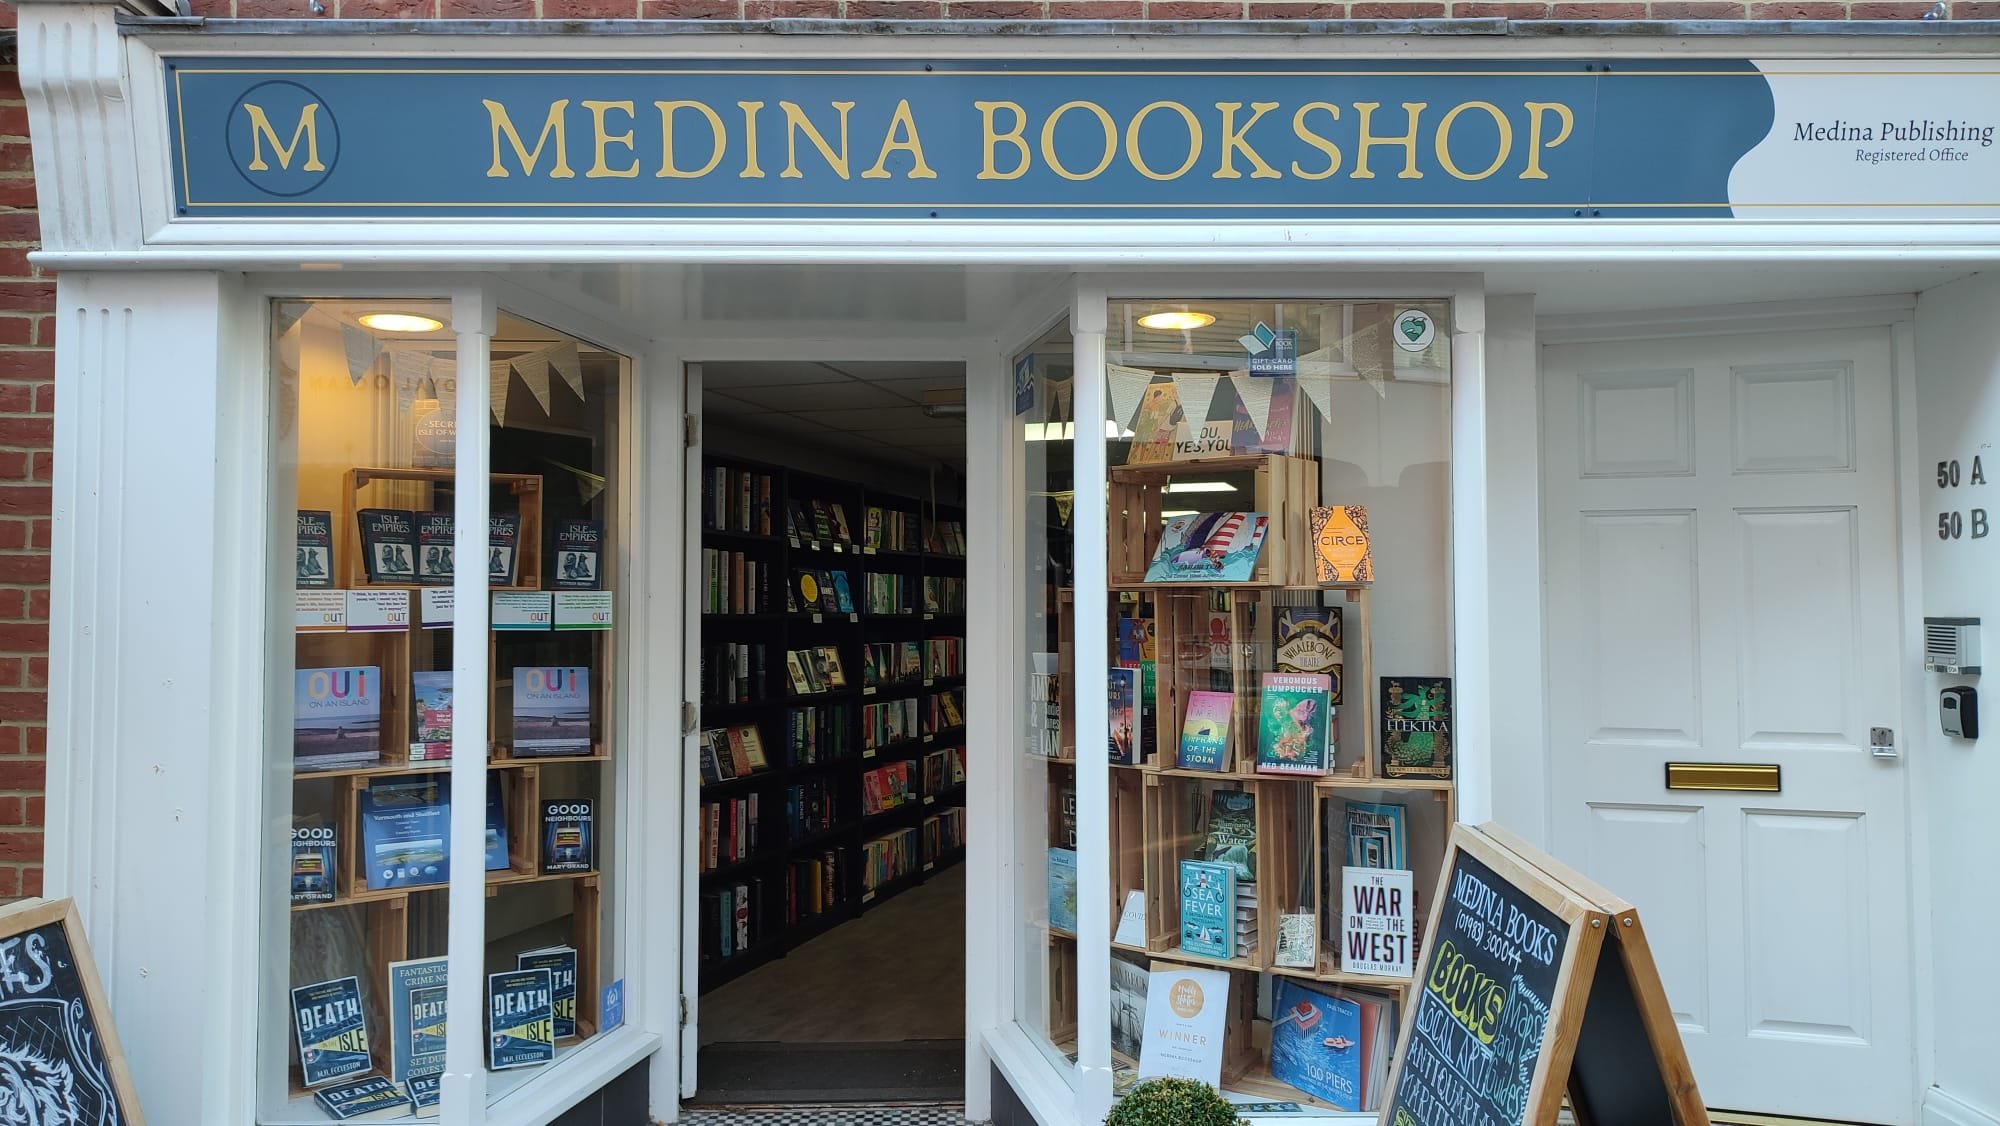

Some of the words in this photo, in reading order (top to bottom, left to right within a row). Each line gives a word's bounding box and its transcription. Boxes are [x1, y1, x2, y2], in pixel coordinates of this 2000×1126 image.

[244, 102, 326, 172] M
[482, 98, 938, 180] MEDINA
[973, 100, 1575, 181] BOOKSHOP
[1793, 120, 1873, 141] Medina
[1880, 119, 1995, 147] Publishing
[1855, 147, 1926, 165] Registered
[1928, 148, 1969, 161] Office
[1200, 427, 1221, 439] OU,
[1937, 460, 1960, 489] 50
[1970, 455, 1987, 485] A
[297, 517, 315, 526] SLE
[380, 515, 400, 524] ISLE
[431, 517, 451, 526] ISLE
[489, 518, 505, 526] SLE
[1938, 511, 1963, 540] 50
[1971, 508, 1990, 539] B
[298, 525, 327, 535] PIRES
[372, 523, 410, 533] EMPIRES
[421, 525, 455, 535] EMPIRE
[489, 527, 514, 536] PIRES
[569, 525, 588, 533] ISLE
[560, 533, 598, 542] EMPIRES
[1321, 536, 1364, 546] CIRCE
[1282, 641, 1336, 660] WHALEBONE
[1273, 676, 1318, 685] VENOMOUS
[1267, 685, 1323, 694] LUMPSUCKER
[1387, 720, 1449, 732] ELEKTRA
[1184, 736, 1225, 745] ORPHANS
[1186, 745, 1199, 753] OF
[1201, 746, 1217, 754] THE
[1185, 754, 1214, 764] STORM
[1280, 763, 1318, 772] BEAUMAN
[547, 804, 590, 815] GOOD
[1218, 835, 1248, 845] Water
[1371, 876, 1384, 886] THE
[1192, 888, 1215, 902] SEA
[1353, 885, 1402, 917] WAR
[1185, 900, 1223, 917] FEVER
[1349, 915, 1363, 929] ON
[1452, 868, 1504, 932] MEDINA
[1504, 904, 1557, 965] BOOKS
[1386, 918, 1405, 932] THE
[1347, 931, 1407, 964] WEST
[1454, 908, 1485, 947] (01983)
[1483, 930, 1522, 973] 300044
[1352, 962, 1377, 971] DOUGLAS
[1379, 963, 1402, 972] MURRAY
[405, 976, 434, 986] CRIME
[435, 974, 448, 982] NO
[1428, 940, 1507, 1045] BOOKS
[494, 989, 548, 1017] DEATH
[553, 998, 574, 1020] SLE
[300, 998, 361, 1032] DEATH
[1505, 982, 1543, 1044] Maps
[436, 1023, 446, 1038] IS
[527, 1019, 552, 1044] ISLE
[1159, 1029, 1207, 1046] WINNER
[338, 1028, 368, 1052] ISLE
[410, 1057, 427, 1067] SET
[515, 1052, 544, 1061] ECCLESTON
[1456, 1035, 1491, 1089] ART
[331, 1061, 361, 1075] ECCLESTON
[407, 1066, 439, 1077] COWES
[1306, 1063, 1324, 1081] 100
[1326, 1072, 1353, 1093] PIERS
[1407, 1036, 1496, 1126] ANTIQUARIA
[327, 1081, 389, 1101] DEATH
[1485, 1059, 1524, 1118] Guides
[1400, 1066, 1456, 1126] MARITI
